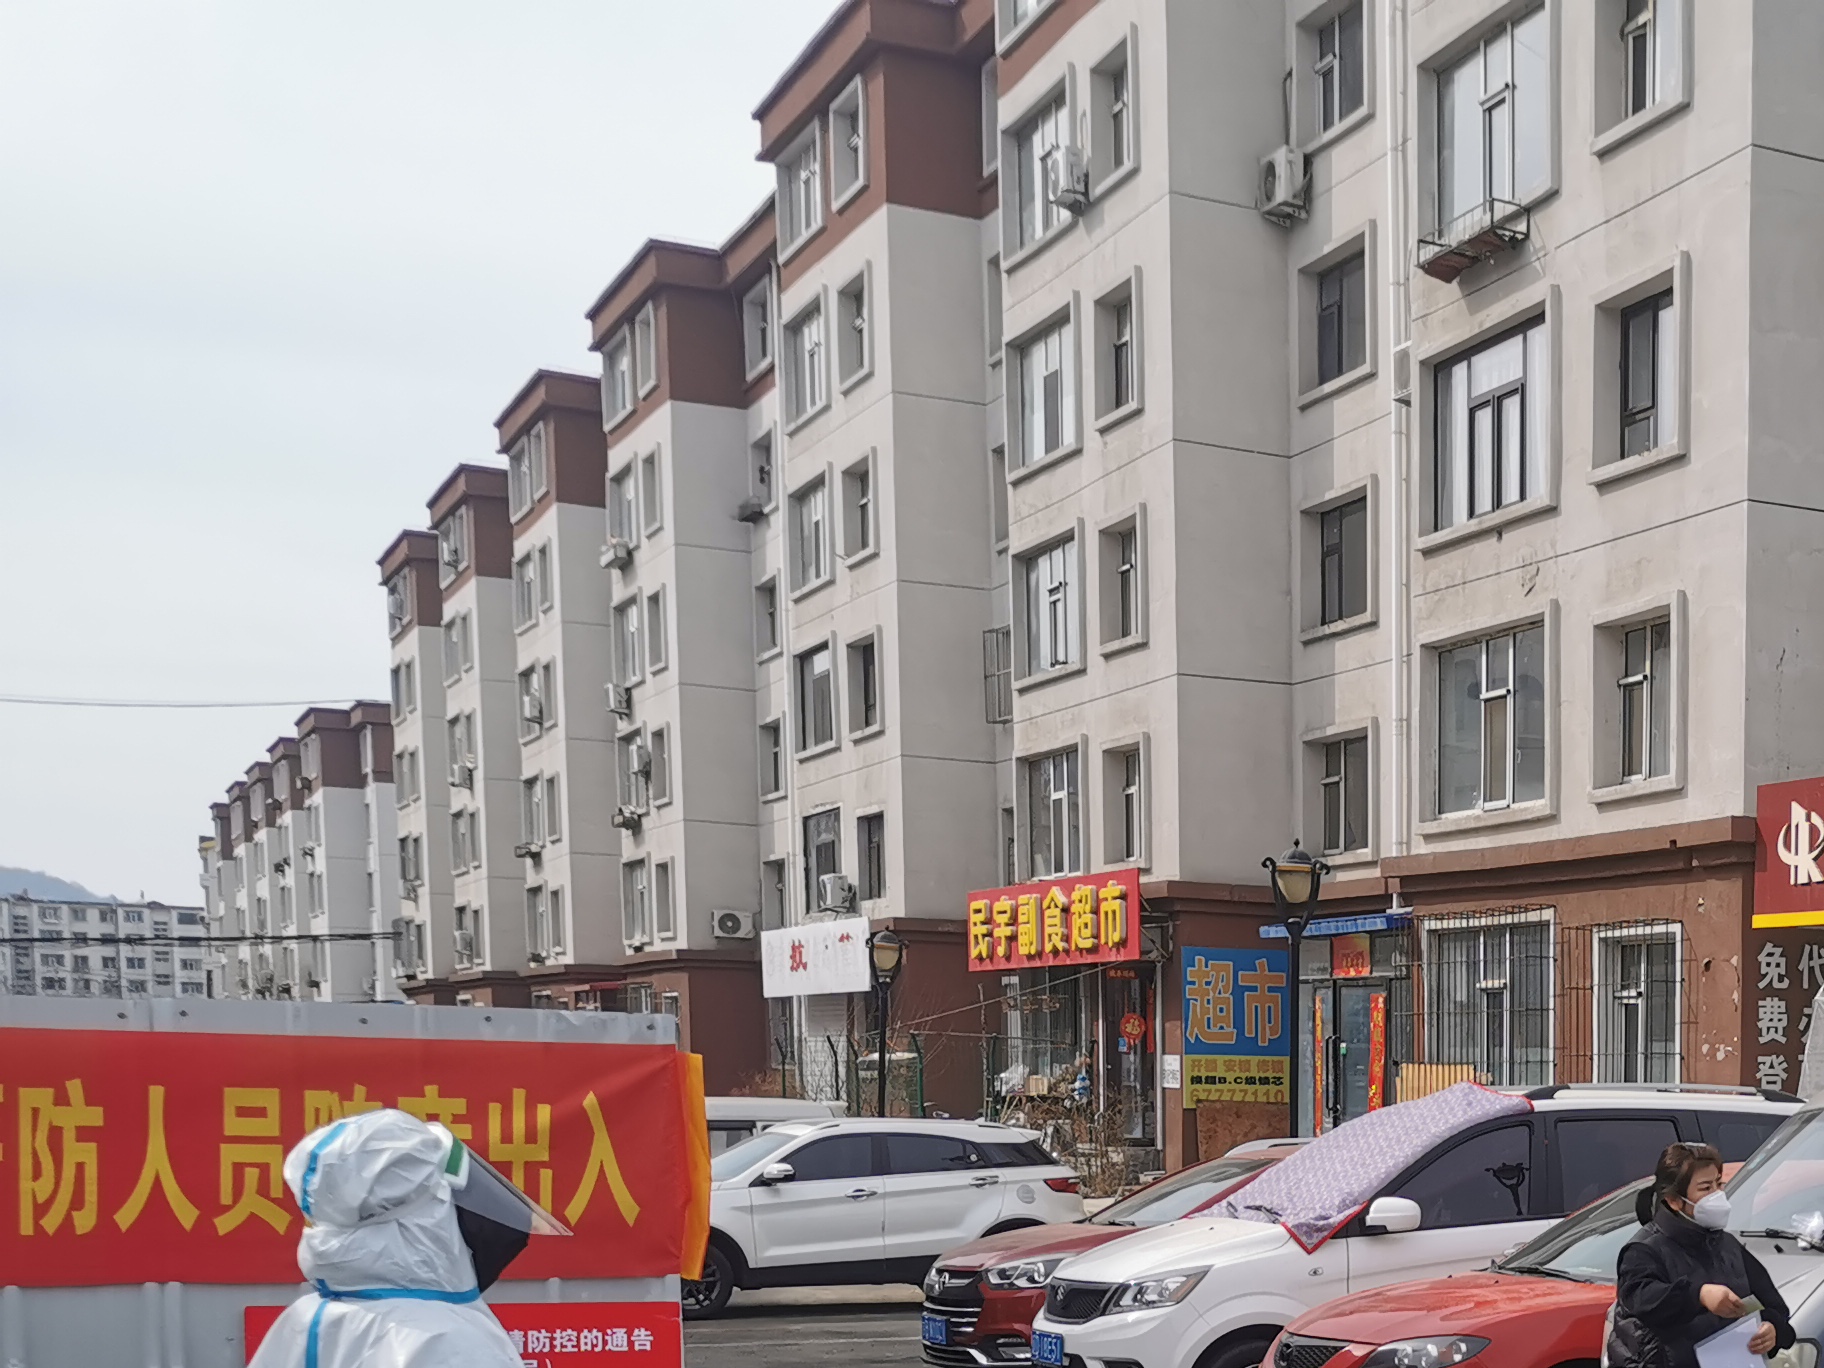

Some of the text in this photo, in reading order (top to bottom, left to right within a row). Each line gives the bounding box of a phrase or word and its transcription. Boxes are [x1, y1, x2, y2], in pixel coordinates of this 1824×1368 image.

[1186, 955, 1286, 1047] 超市
[0, 1078, 641, 1237] 防人员出入
